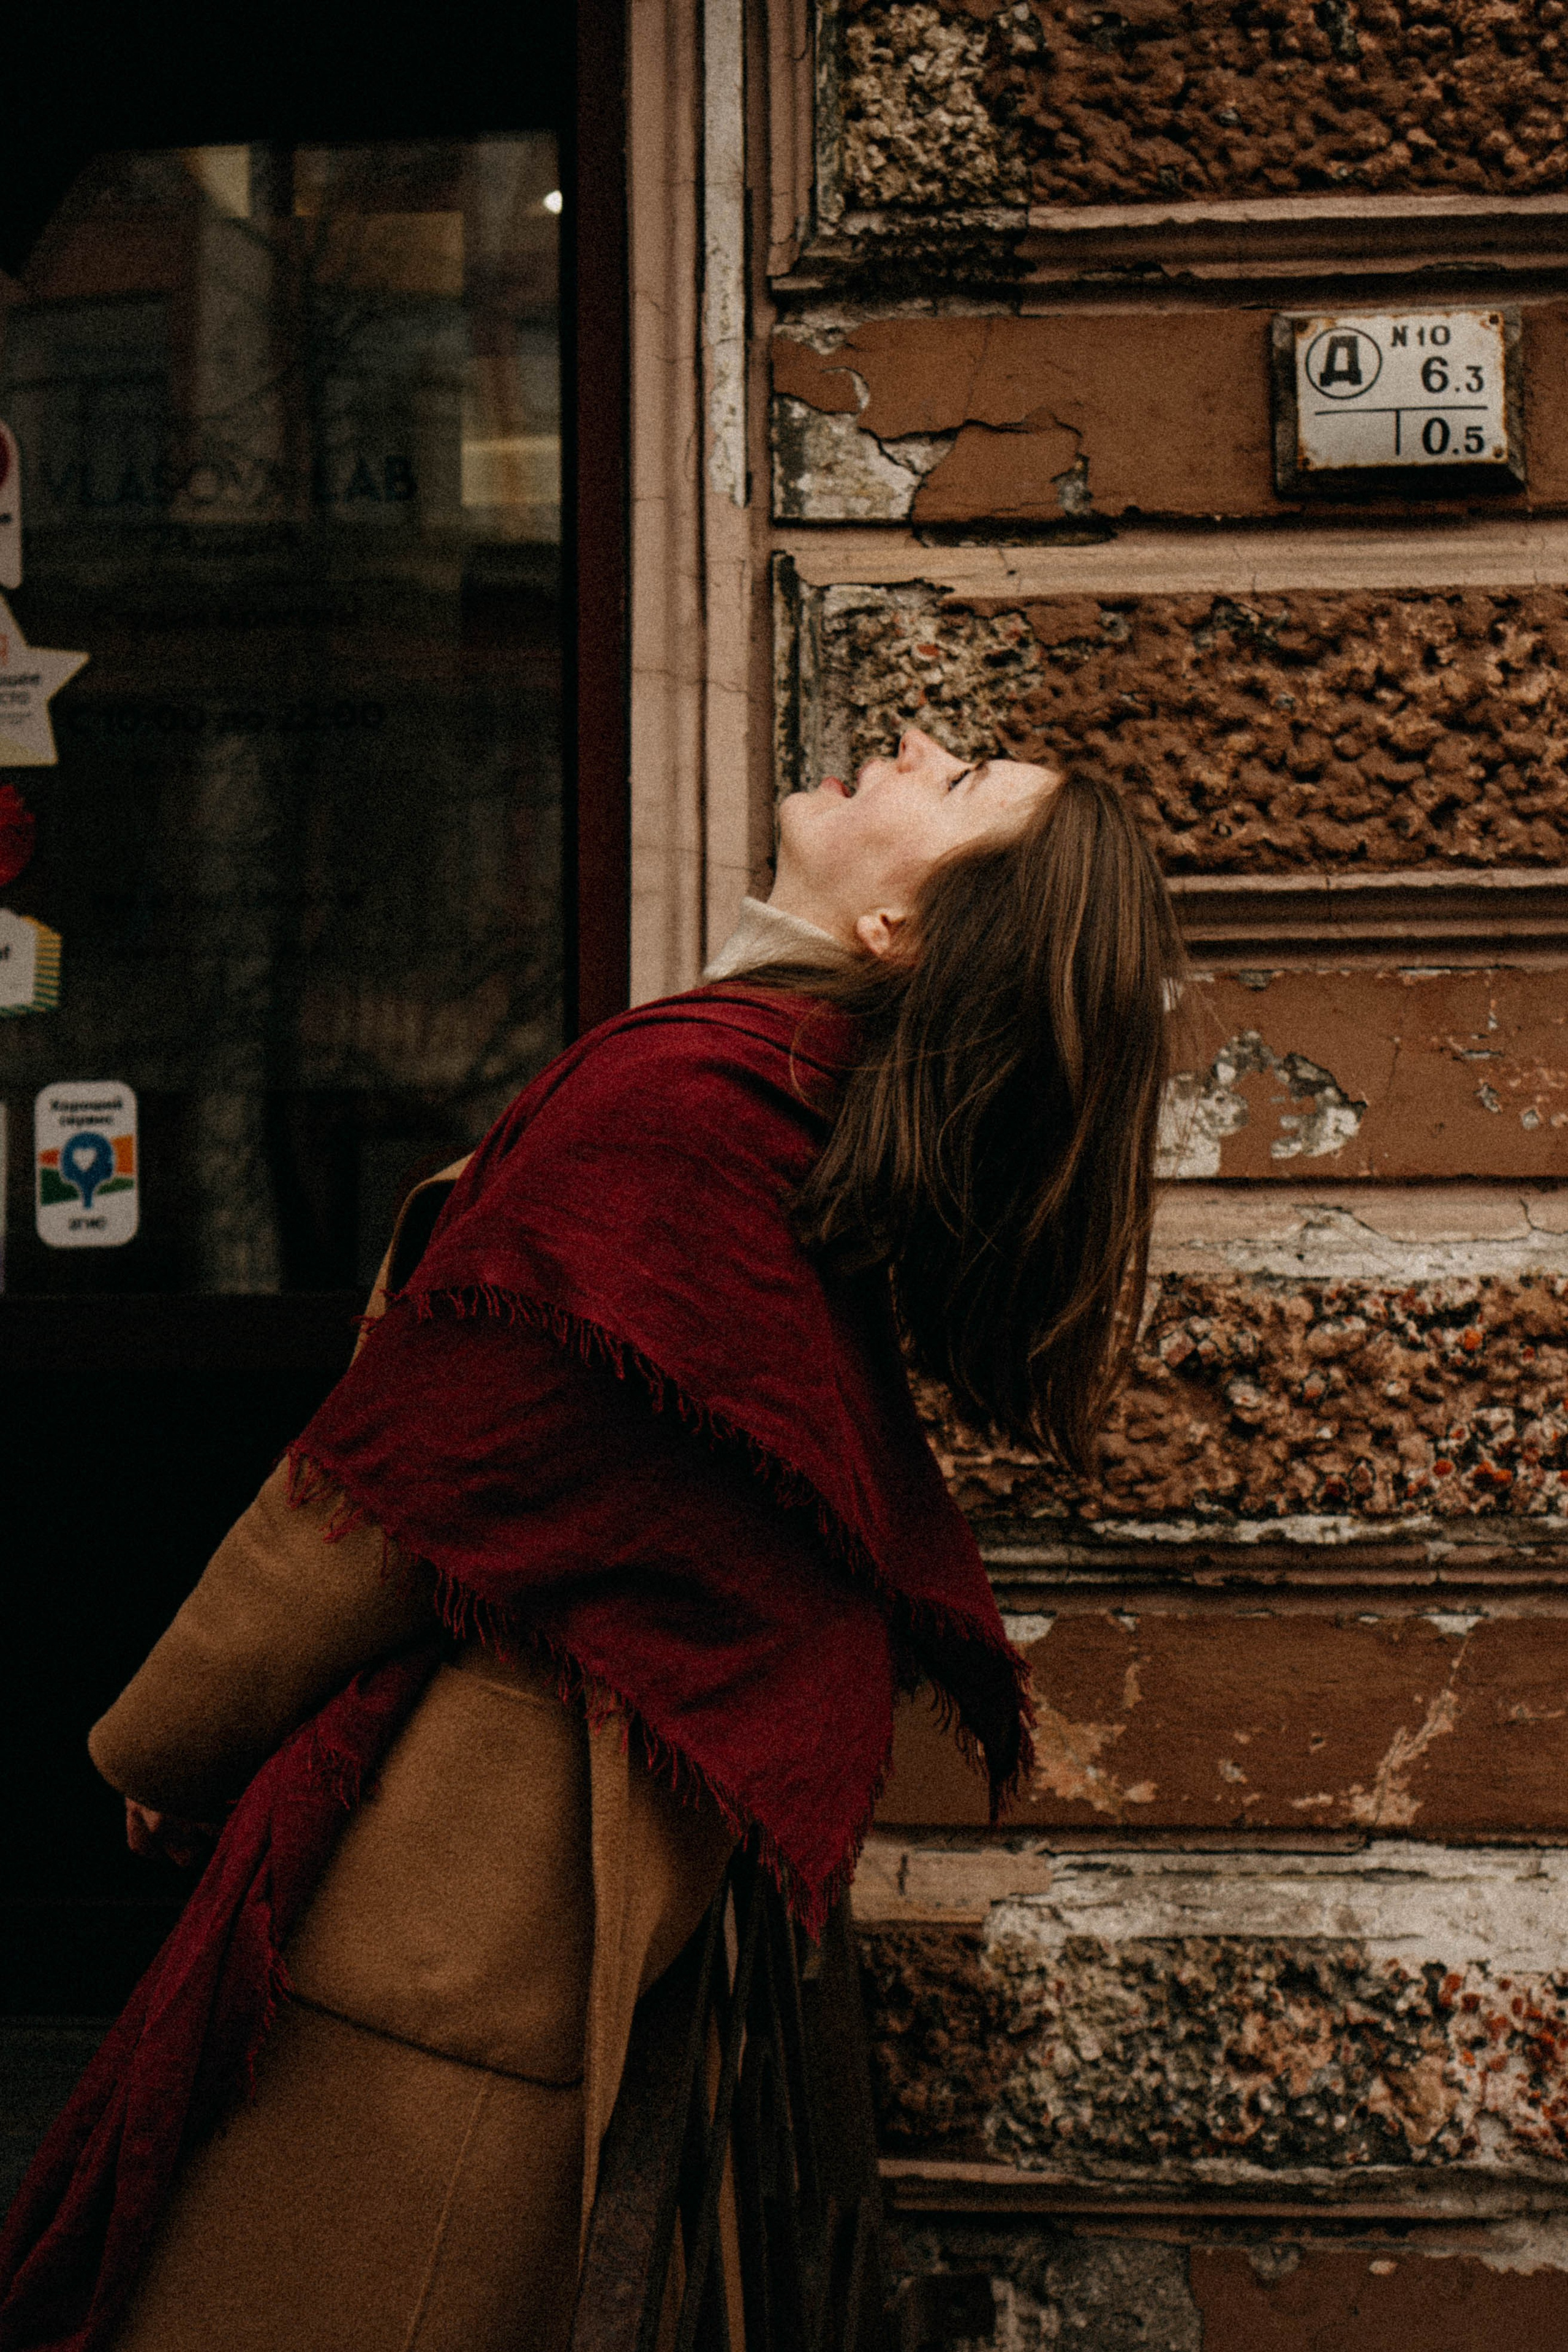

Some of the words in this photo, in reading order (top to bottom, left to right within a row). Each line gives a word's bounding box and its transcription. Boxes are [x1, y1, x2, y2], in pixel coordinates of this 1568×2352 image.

[1319, 335, 1362, 387] Д
[1421, 356, 1485, 394] 6.3
[1422, 417, 1485, 456] 0.5
[313, 454, 418, 503] LAB
